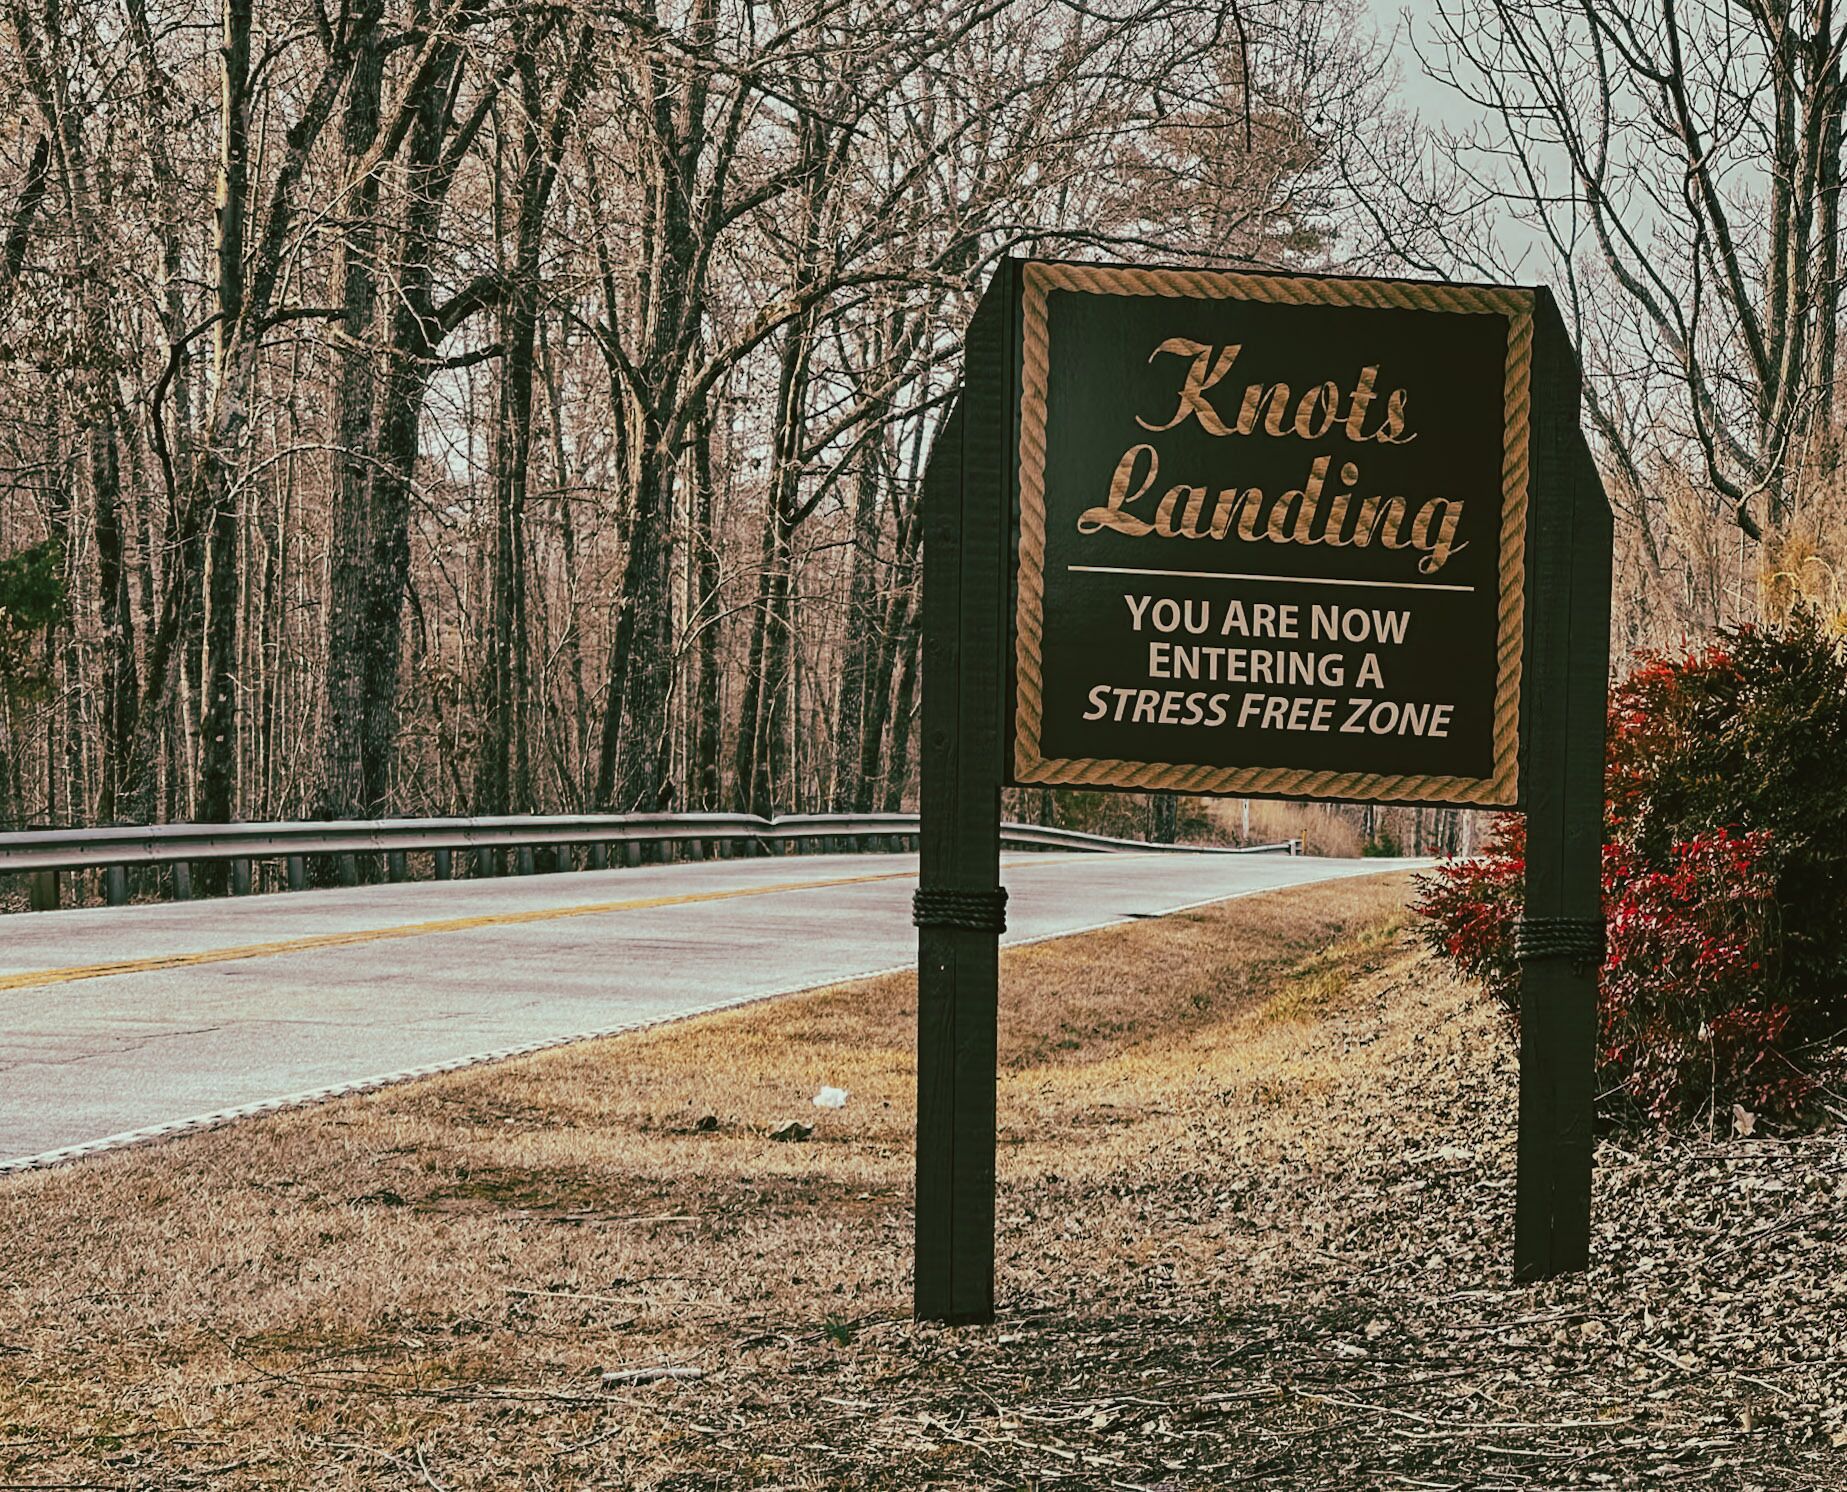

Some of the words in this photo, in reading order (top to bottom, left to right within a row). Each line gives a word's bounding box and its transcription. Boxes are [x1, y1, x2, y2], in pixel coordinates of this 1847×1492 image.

[1136, 337, 1417, 444] Knots
[1077, 444, 1469, 574] Landing
[1124, 595, 1209, 634] YOU
[1221, 601, 1299, 638] ARE
[1311, 605, 1410, 644] NOW
[1149, 642, 1344, 686] ENTERING
[1356, 653, 1384, 688] A
[1083, 685, 1229, 727] STRESS
[1237, 693, 1334, 732] FREE
[1340, 699, 1454, 737] ZONE
